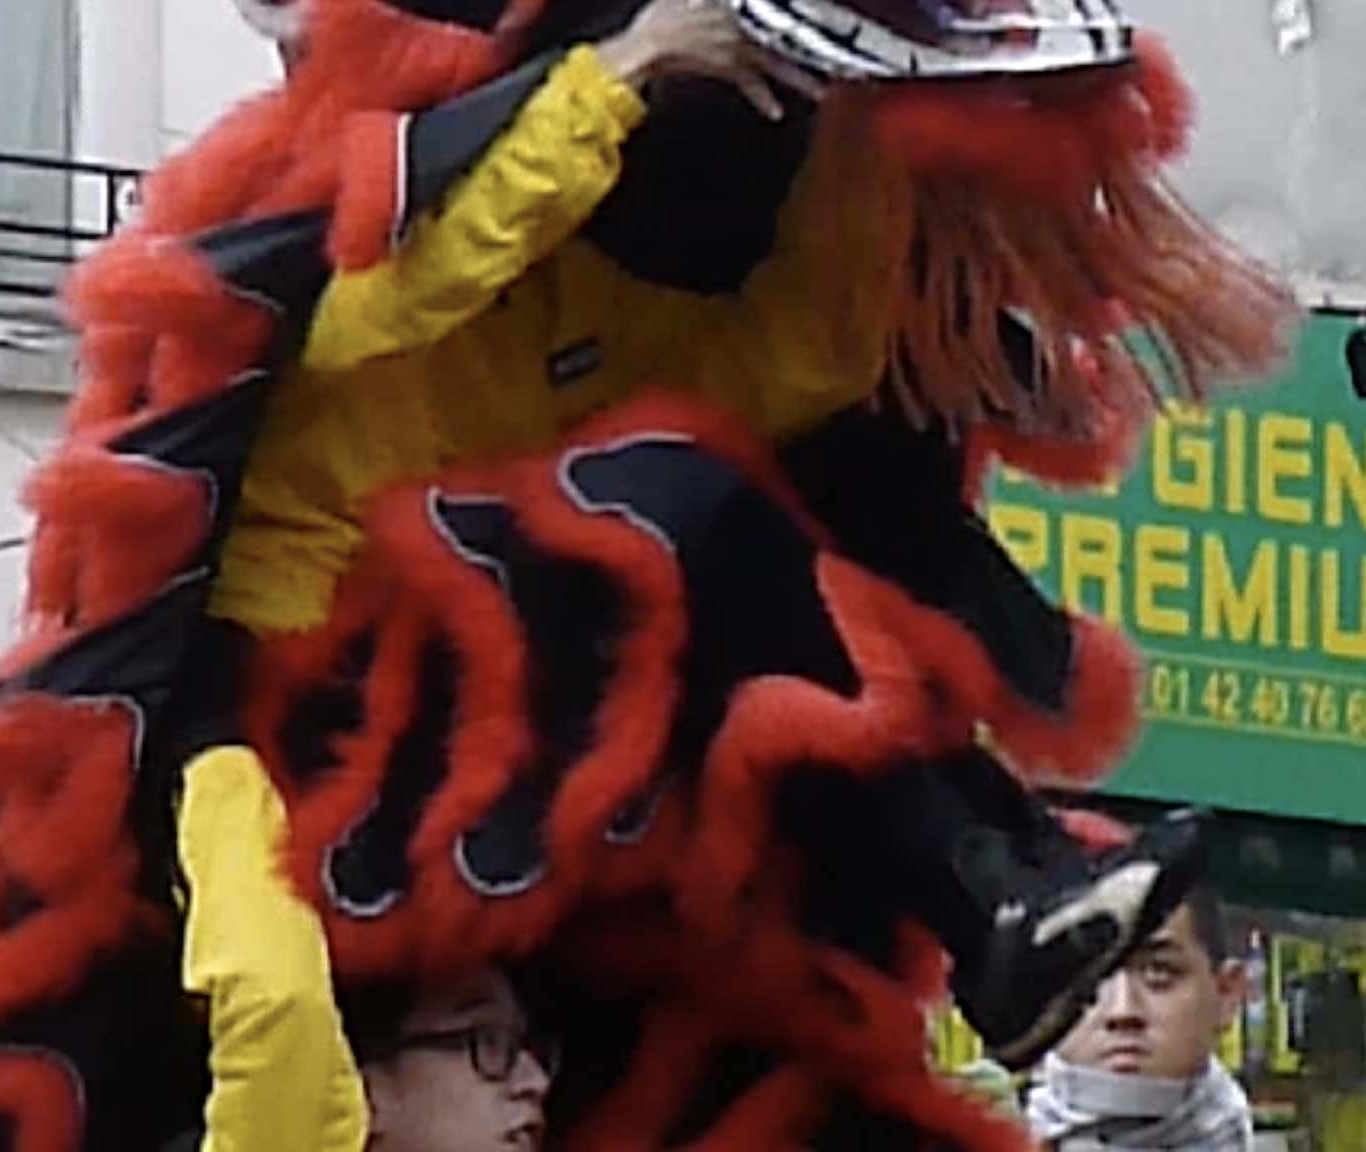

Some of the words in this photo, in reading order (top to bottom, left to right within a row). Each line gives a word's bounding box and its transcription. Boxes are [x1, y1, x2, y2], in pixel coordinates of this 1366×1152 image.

[1151, 664, 1189, 716] 01
[1202, 670, 1239, 727] 42
[1252, 676, 1288, 728] 40
[1299, 680, 1337, 730] 76
